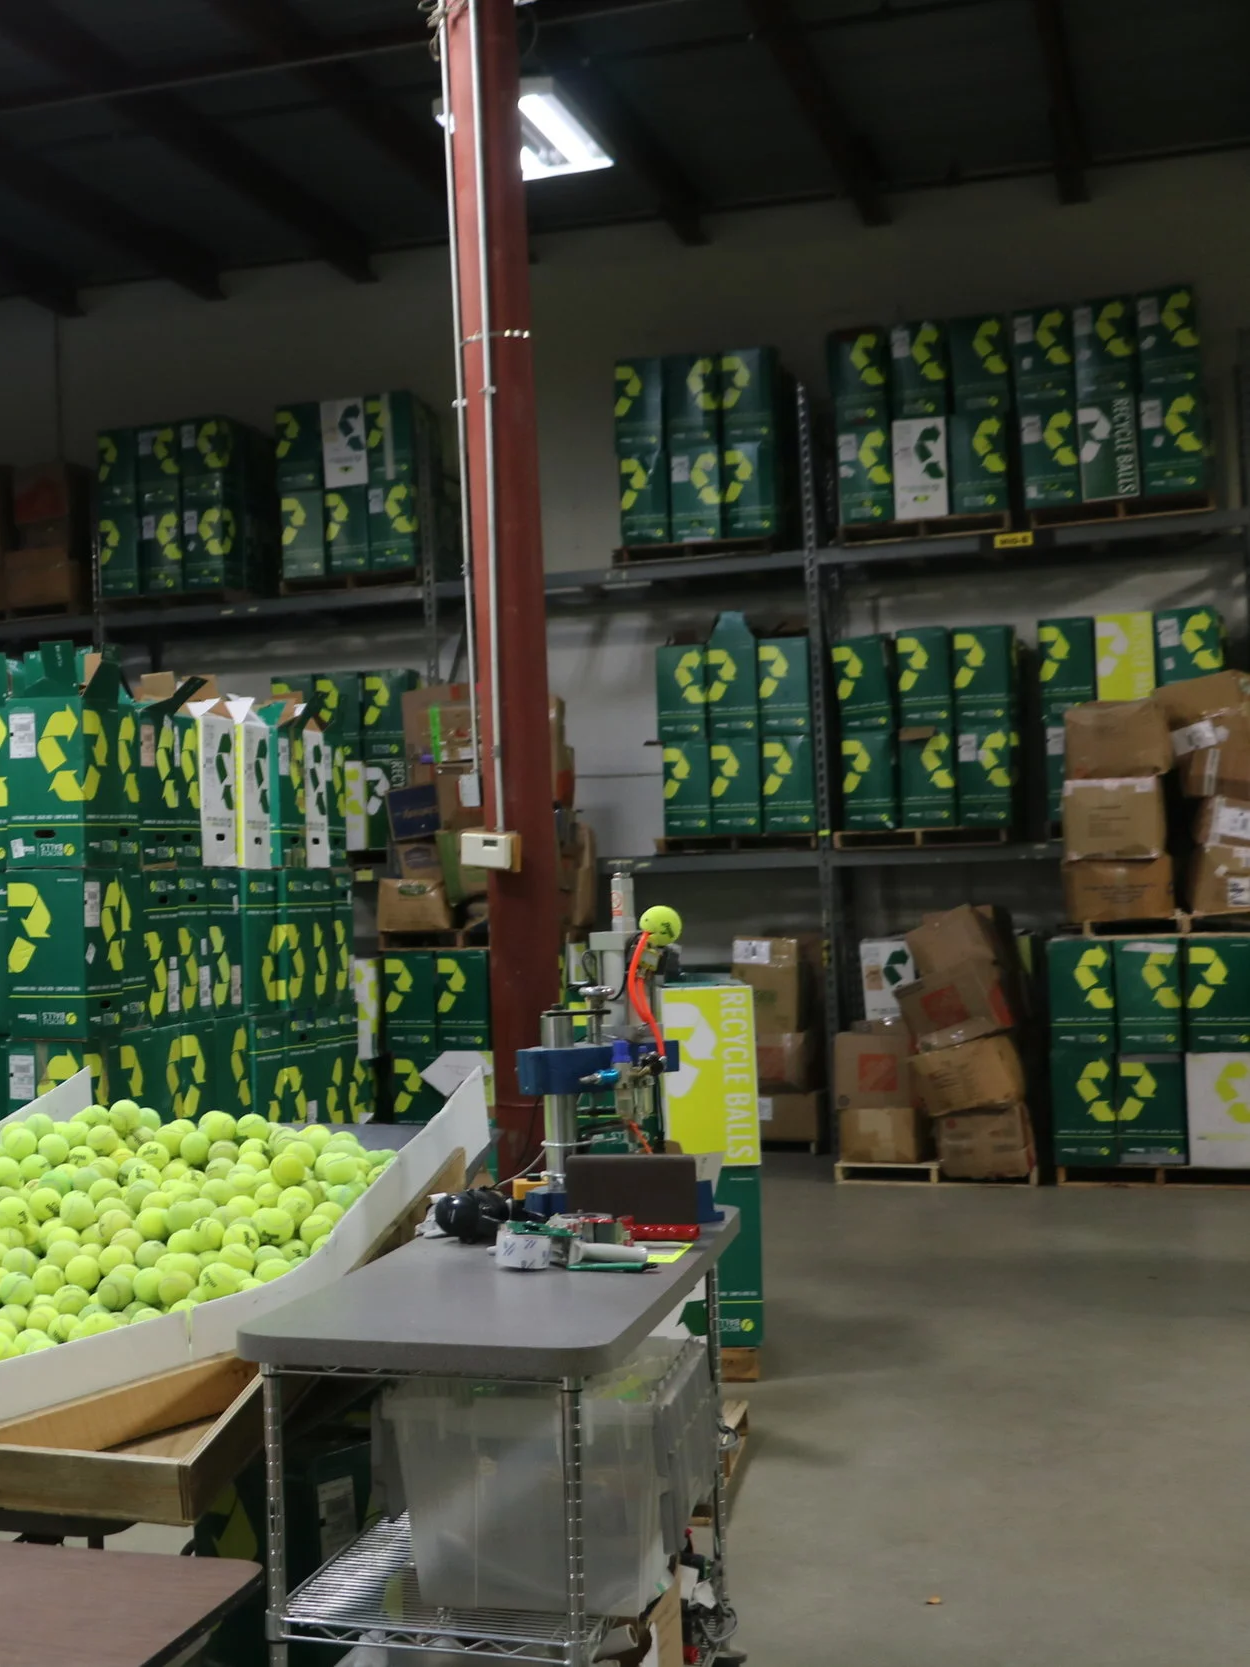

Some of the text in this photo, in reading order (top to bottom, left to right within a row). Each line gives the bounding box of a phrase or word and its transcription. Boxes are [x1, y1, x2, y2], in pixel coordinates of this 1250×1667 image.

[1115, 454, 1135, 494] BALLS
[720, 992, 754, 1160] RECYCLE BALLS
